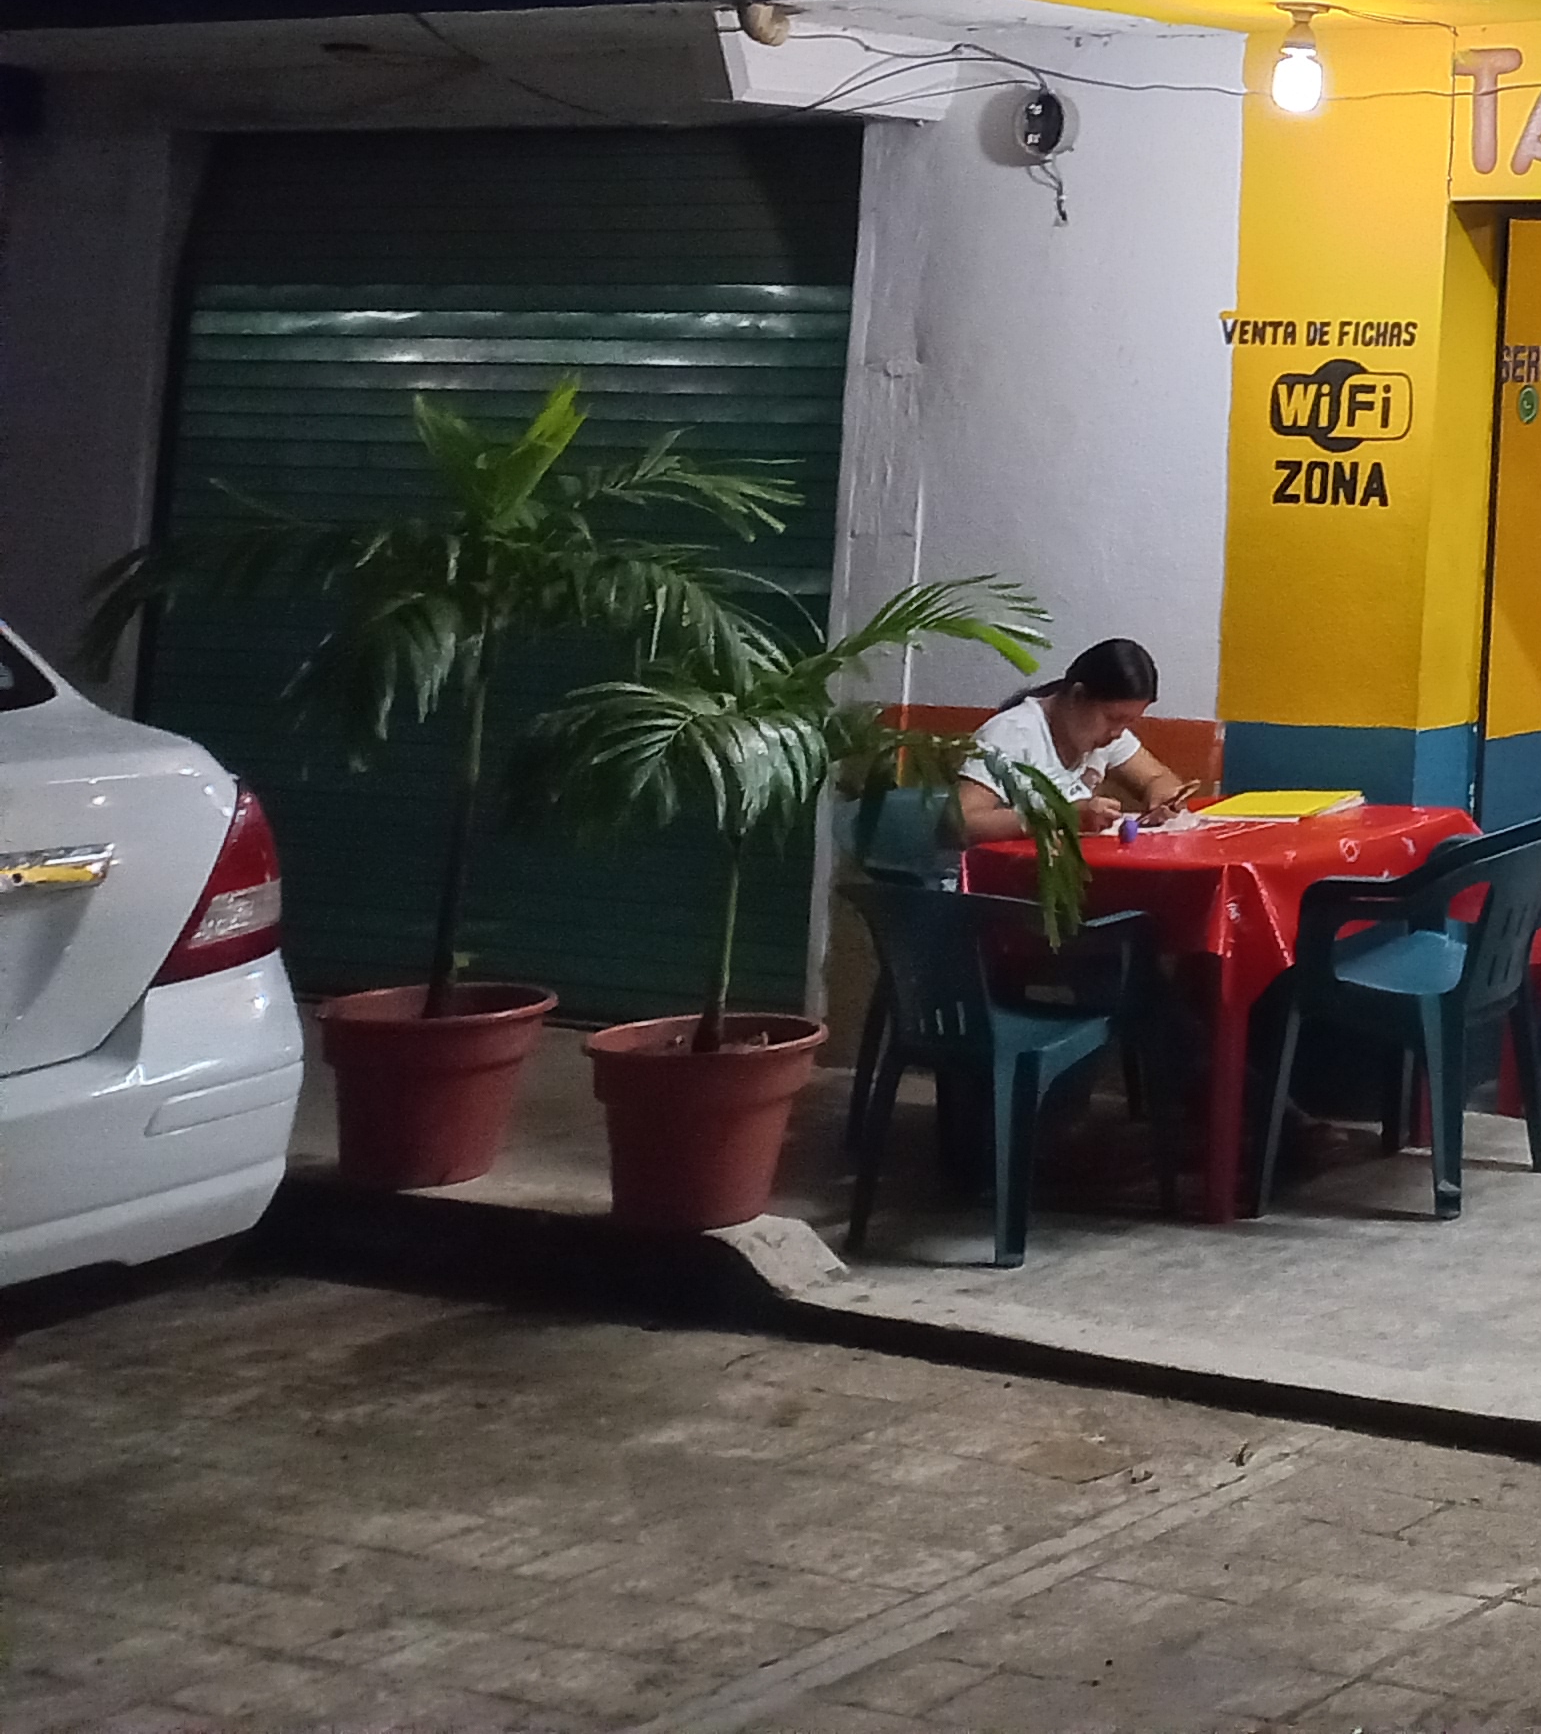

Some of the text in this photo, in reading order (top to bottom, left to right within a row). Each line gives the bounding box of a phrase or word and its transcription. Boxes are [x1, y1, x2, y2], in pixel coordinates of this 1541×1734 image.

[1221, 319, 1419, 347] VENTA DE FICHAS
[1271, 459, 1389, 507] ZONA
